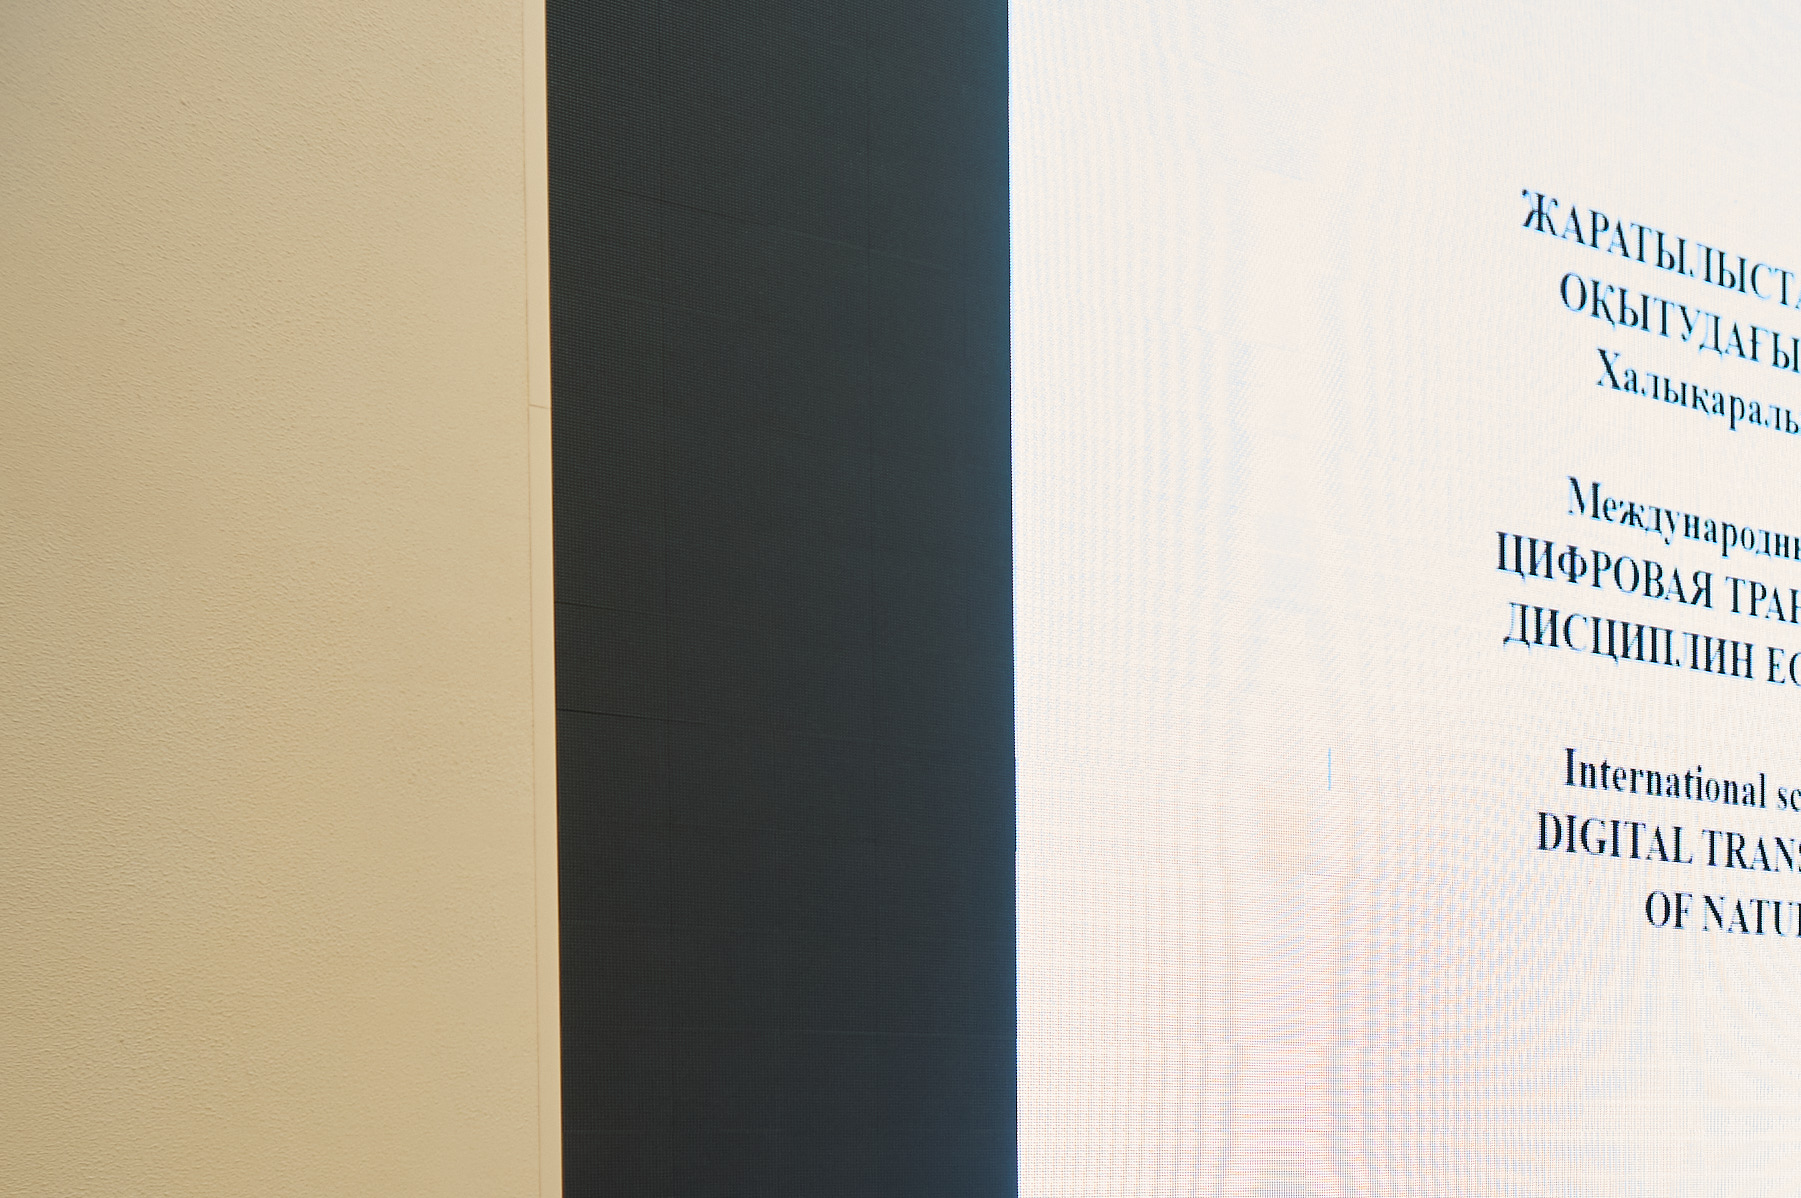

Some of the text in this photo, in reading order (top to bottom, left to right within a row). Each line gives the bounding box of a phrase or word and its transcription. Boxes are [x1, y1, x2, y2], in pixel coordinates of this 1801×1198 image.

[1559, 273, 1800, 374] ОҚЫТУДАҒЫ
[1495, 531, 1713, 609] ЦИФРОВАЯ
[1502, 601, 1754, 680] ДИСЦИПЛИН
[1564, 747, 1766, 809] International
[1536, 811, 1693, 865] DIGITAL
[1644, 890, 1693, 930] OF
